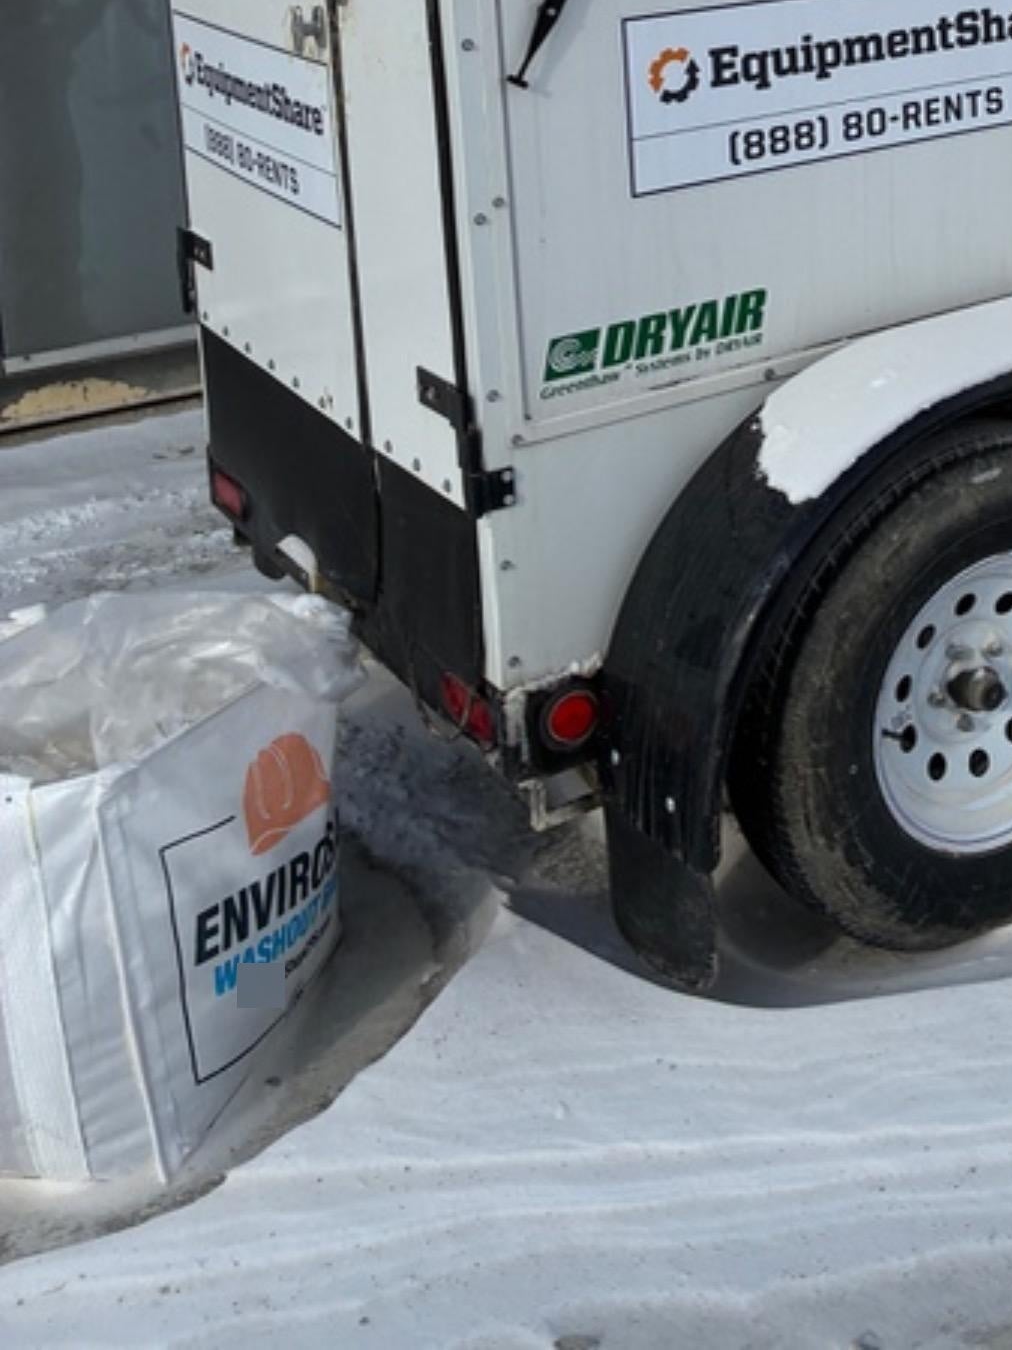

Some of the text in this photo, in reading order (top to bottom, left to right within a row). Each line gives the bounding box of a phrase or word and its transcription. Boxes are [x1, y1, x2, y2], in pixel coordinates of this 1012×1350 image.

[195, 51, 324, 136] EquipmentShare
[728, 87, 1004, 166] (888) 80-RENTS
[601, 287, 768, 370] DRYAIR
